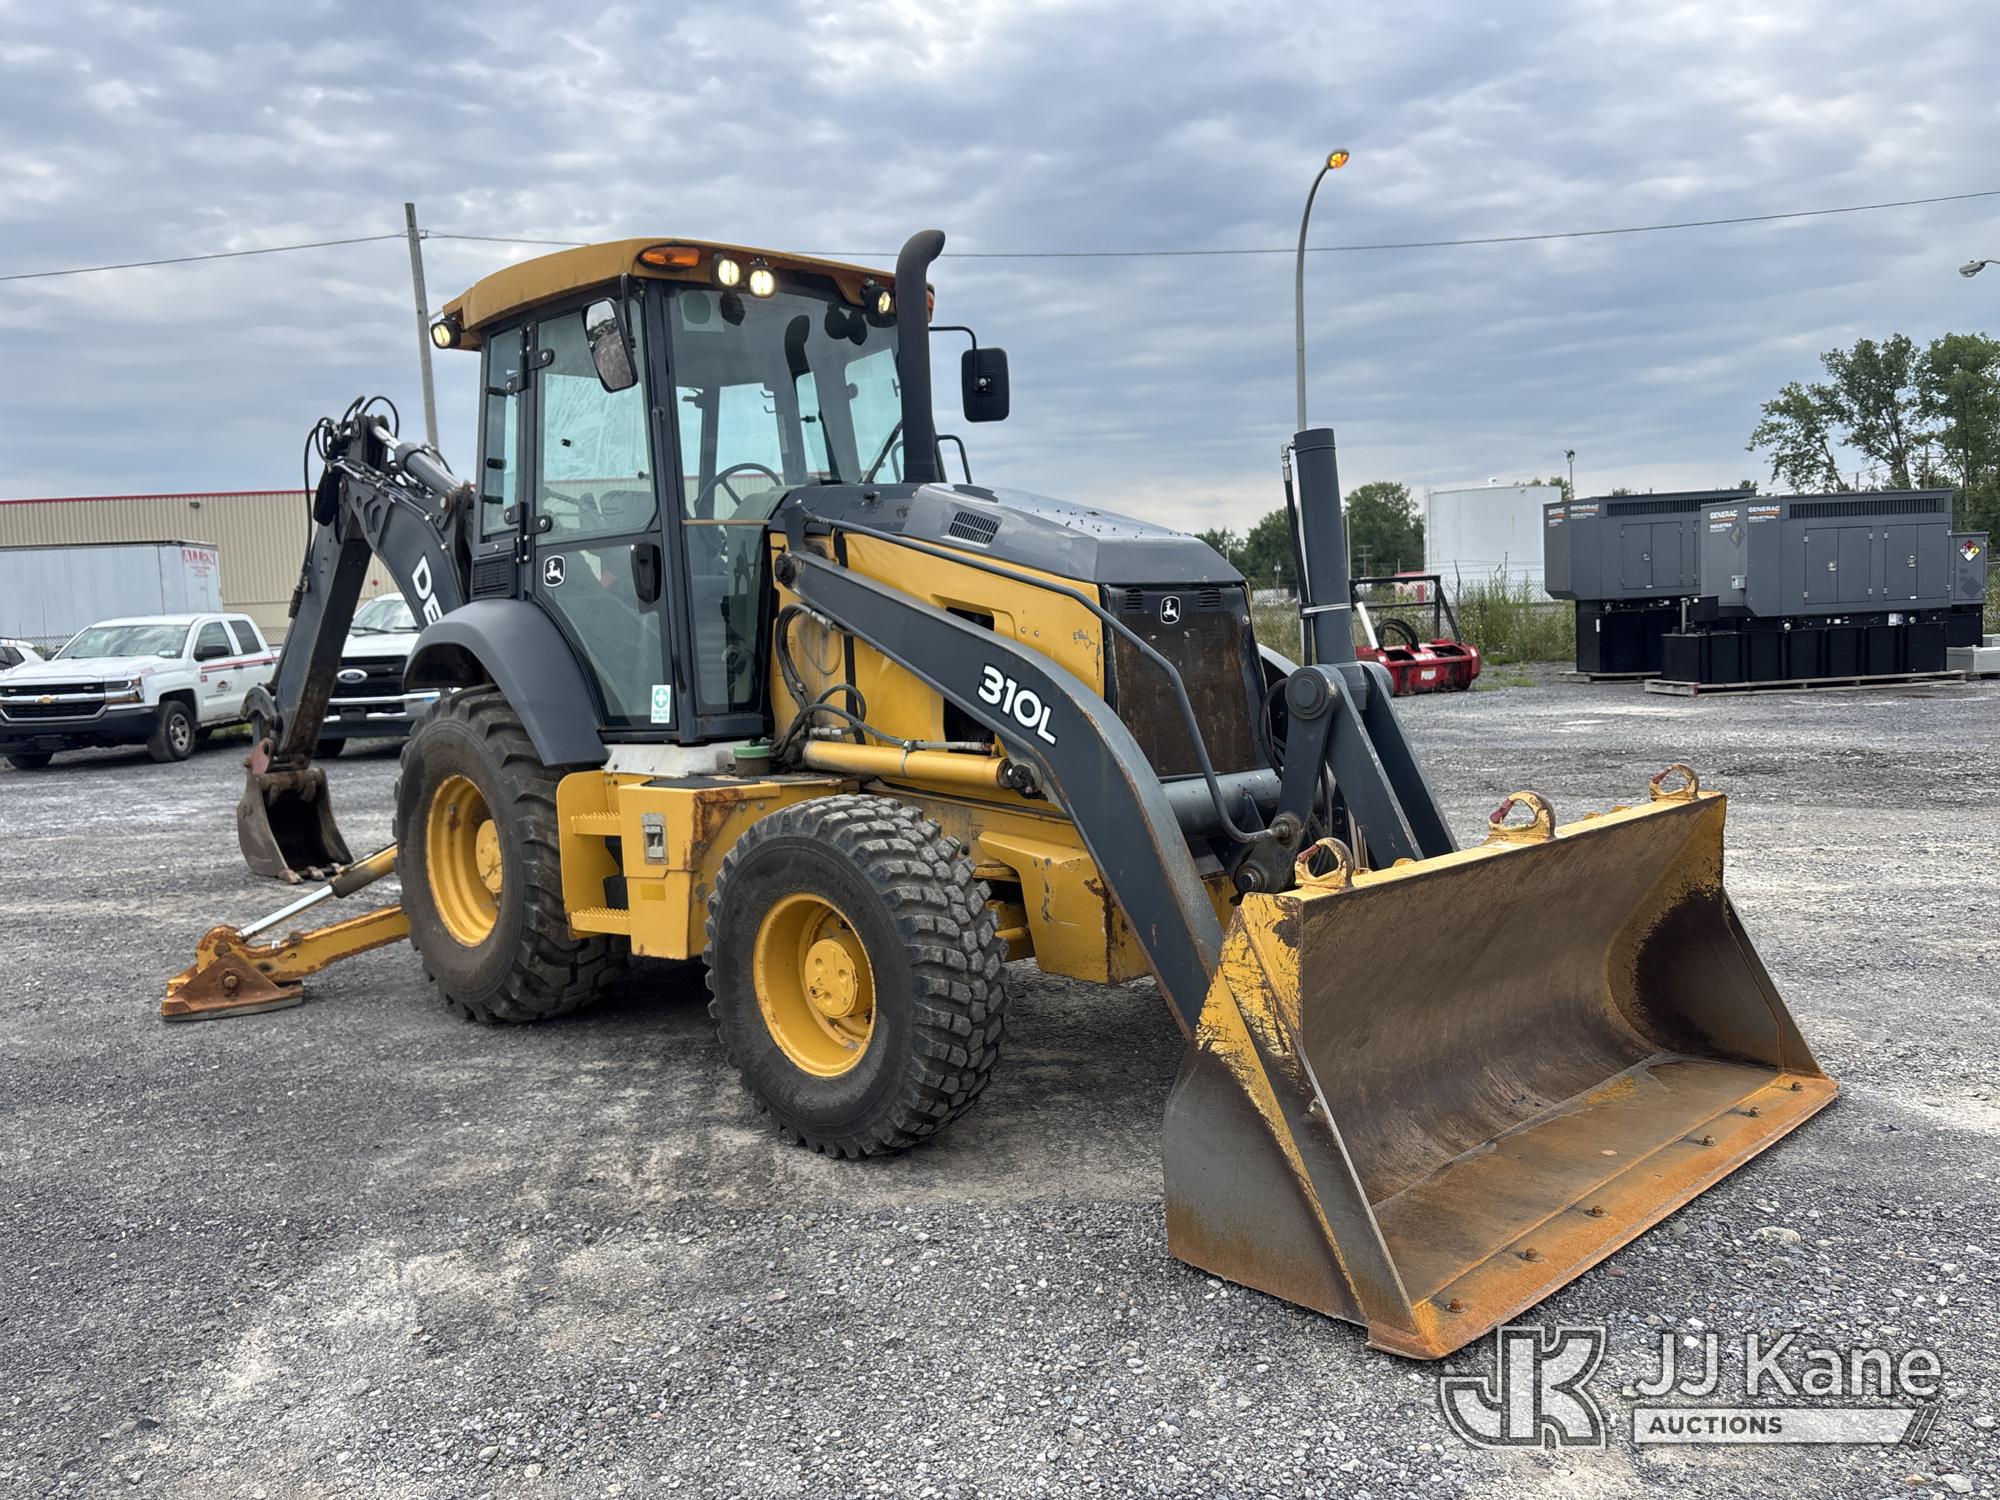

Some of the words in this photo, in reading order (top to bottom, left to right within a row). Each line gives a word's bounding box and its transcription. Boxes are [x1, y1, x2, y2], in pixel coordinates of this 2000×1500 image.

[1710, 509, 1738, 519] GENERAC
[1748, 505, 1780, 513] GENERAC
[977, 665, 1056, 745] 310L
